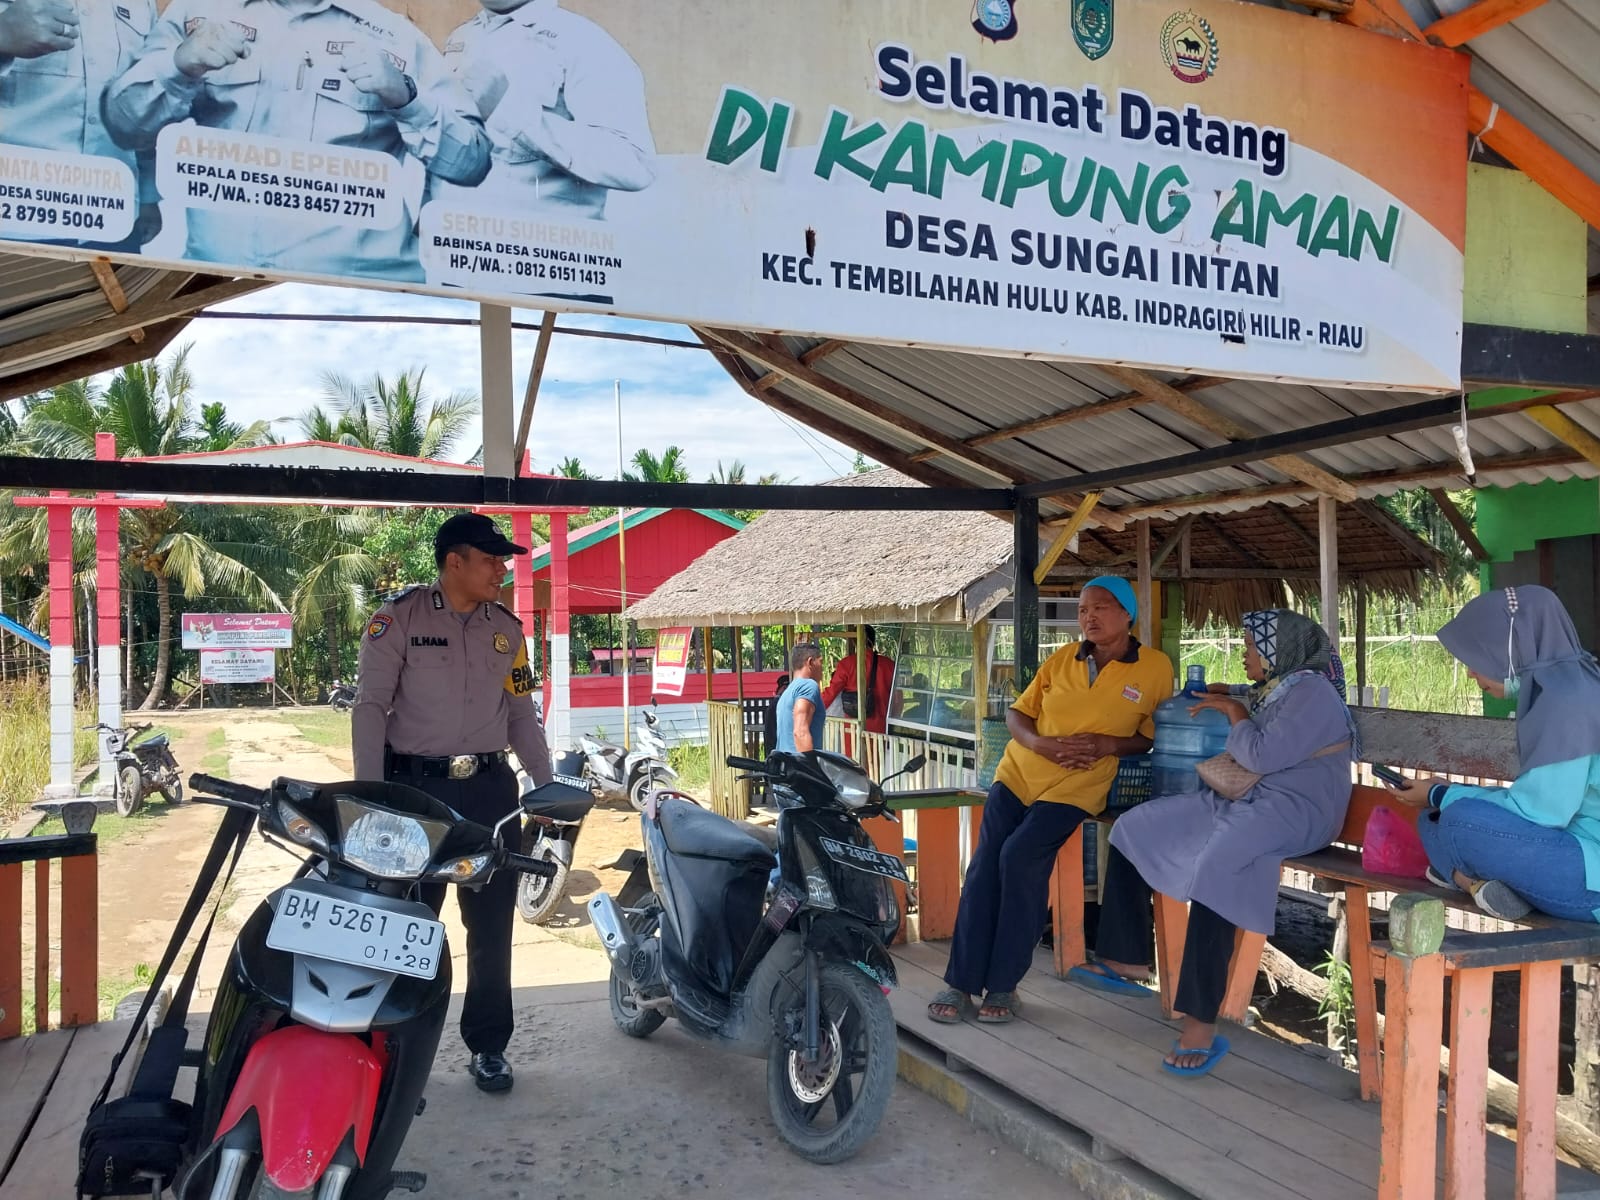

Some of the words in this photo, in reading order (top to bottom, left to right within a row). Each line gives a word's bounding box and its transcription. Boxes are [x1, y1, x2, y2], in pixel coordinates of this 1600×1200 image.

[878, 46, 1103, 134] Selamat
[1120, 92, 1286, 176] Datang
[175, 135, 281, 168] AHMAD
[291, 151, 389, 183] EPENDI
[44, 162, 123, 191] SYAPUTRA
[176, 162, 236, 181] KEPALA
[241, 170, 279, 186] DESA
[283, 176, 338, 194] SUNGAI
[343, 183, 386, 200] INTAN
[706, 88, 791, 173] DI
[813, 109, 1192, 234] KAMPUNG
[1210, 178, 1399, 264] AMAN
[0, 184, 33, 200] DESA
[36, 189, 83, 206] SUNGAI
[87, 194, 125, 211] INTAN
[264, 190, 300, 209] 0823
[304, 195, 340, 213] 8457
[343, 202, 376, 218] 2771
[0, 202, 12, 220] 2
[16, 204, 57, 225] 8799
[62, 210, 105, 230] 5004
[442, 212, 504, 237] SERTU
[509, 220, 615, 251] SUHERMAN
[433, 236, 492, 253] BABINSA
[496, 242, 529, 257] DESA
[533, 247, 581, 263] SUNGAI
[584, 254, 622, 269] INTAN
[886, 211, 999, 262] DESA
[1011, 228, 1159, 282] SUNGAI
[1171, 251, 1279, 299] INTAN
[515, 260, 546, 279] 0812
[549, 264, 577, 283] 6151
[579, 268, 606, 286] 1413
[761, 252, 822, 286] KEC.
[830, 260, 999, 307] TEMBILAHAN
[1007, 282, 1069, 315] HULU
[1076, 292, 1129, 322] KAB.
[1135, 298, 1244, 334] INDRAGIRI
[1250, 312, 1301, 342] HILIR
[1319, 321, 1363, 349] RIAU
[224, 617, 252, 626] Selamat
[254, 617, 279, 627] Datang
[411, 636, 448, 647] ILHAM
[823, 839, 845, 857] BM
[845, 847, 880, 863] 2802
[283, 895, 320, 922] BM
[329, 904, 387, 937] 5261
[405, 922, 435, 946] GJ
